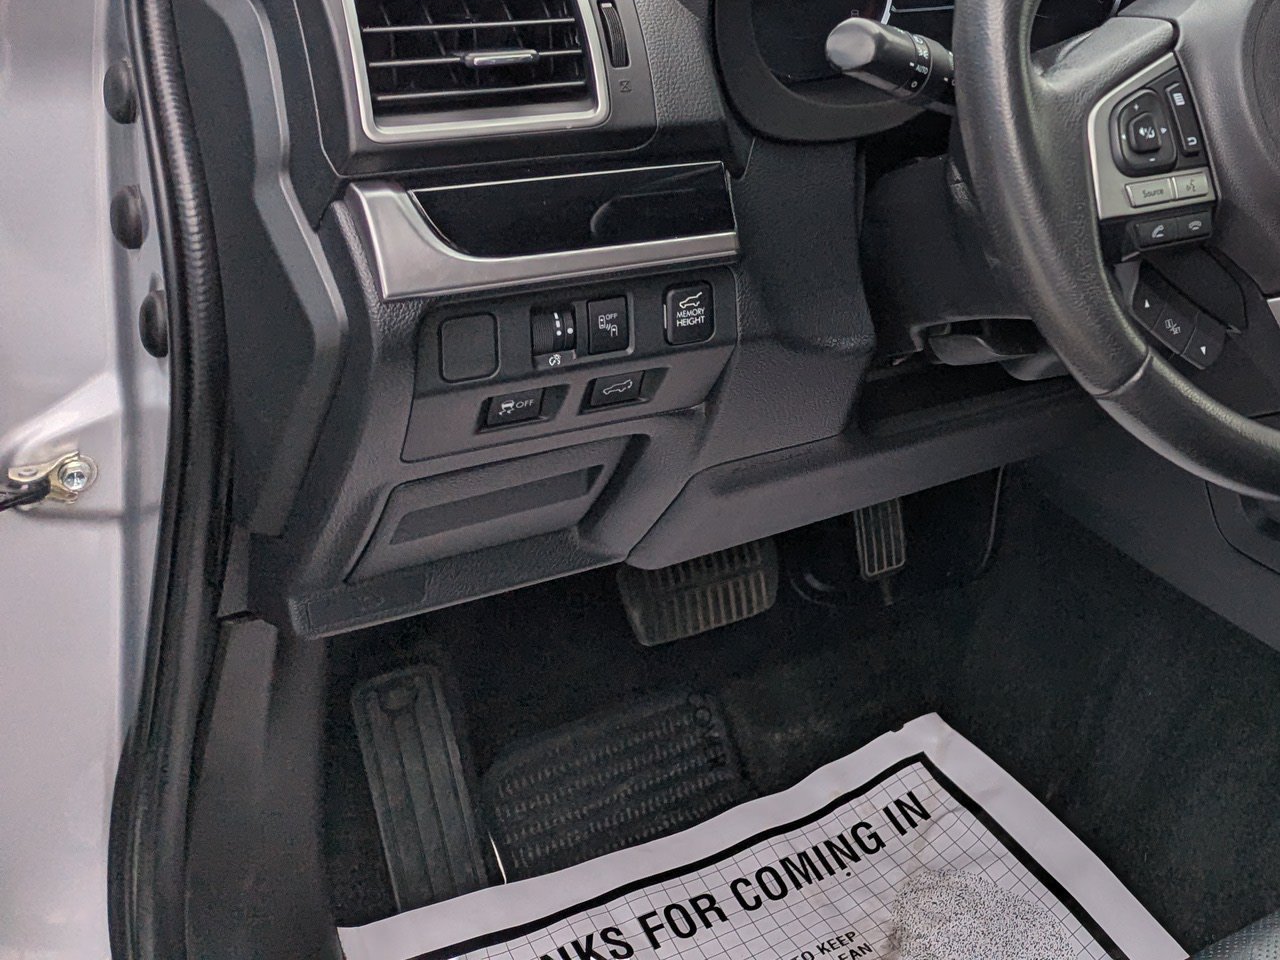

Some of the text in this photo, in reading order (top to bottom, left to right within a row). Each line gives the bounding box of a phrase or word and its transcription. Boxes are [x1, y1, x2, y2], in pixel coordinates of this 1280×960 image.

[1142, 188, 1164, 198] Source
[605, 312, 618, 321] OFF
[676, 307, 705, 318] MEMORY
[676, 316, 705, 327] HEIGHT
[516, 399, 534, 409] OFF
[637, 893, 729, 950] FOR
[730, 821, 887, 911] COMING
[882, 791, 932, 836] IN
[816, 931, 857, 956] KEEP
